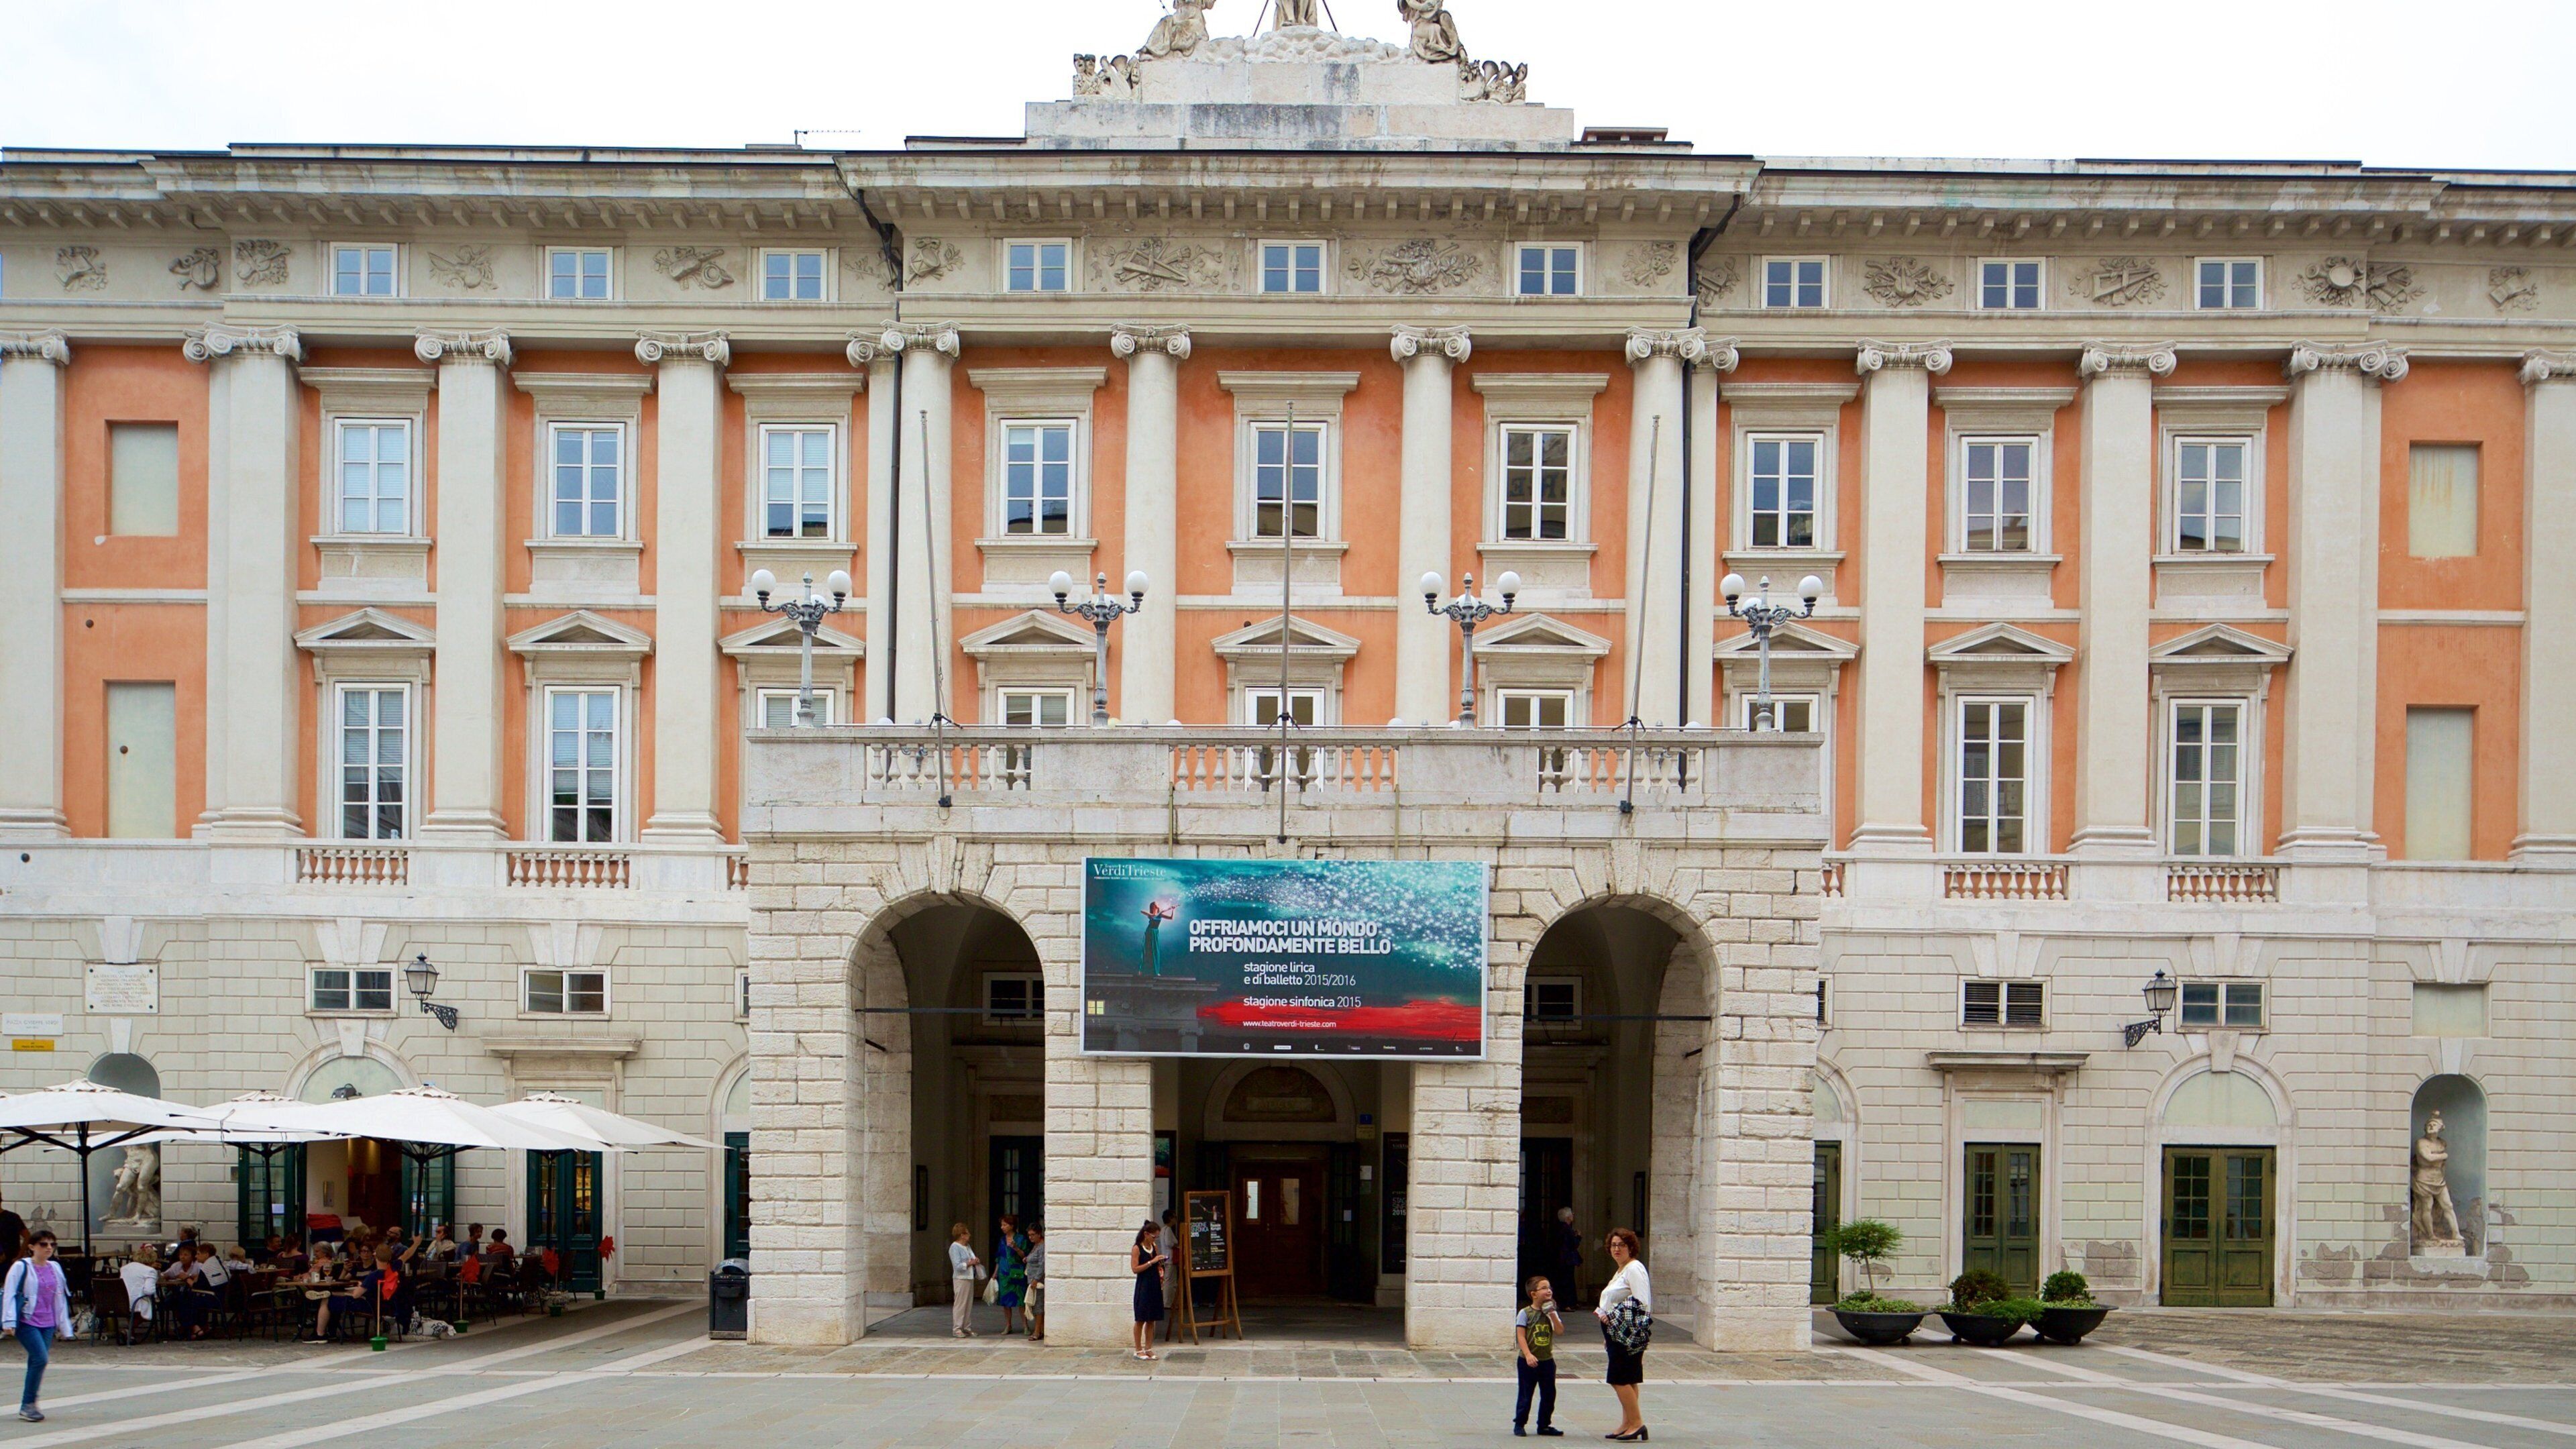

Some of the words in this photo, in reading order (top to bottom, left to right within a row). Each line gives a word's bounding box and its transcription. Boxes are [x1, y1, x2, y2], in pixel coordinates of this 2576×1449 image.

[1189, 920, 1288, 936] OFFRIAMOCI
[1291, 920, 1315, 936] UN
[1318, 920, 1378, 937] MONDO
[1189, 937, 1336, 953] PROFONDAMENTE
[1338, 938, 1392, 955] BELLO
[1244, 961, 1288, 975] stagione
[1290, 961, 1315, 973] lirica
[1244, 977, 1251, 985] e
[1252, 974, 1263, 985] di
[1264, 975, 1303, 985] balletto
[1305, 974, 1356, 986] 2015/2016
[1244, 996, 1288, 1009] stagione
[1289, 996, 1335, 1007] sinfonica
[1337, 996, 1362, 1008] 2015
